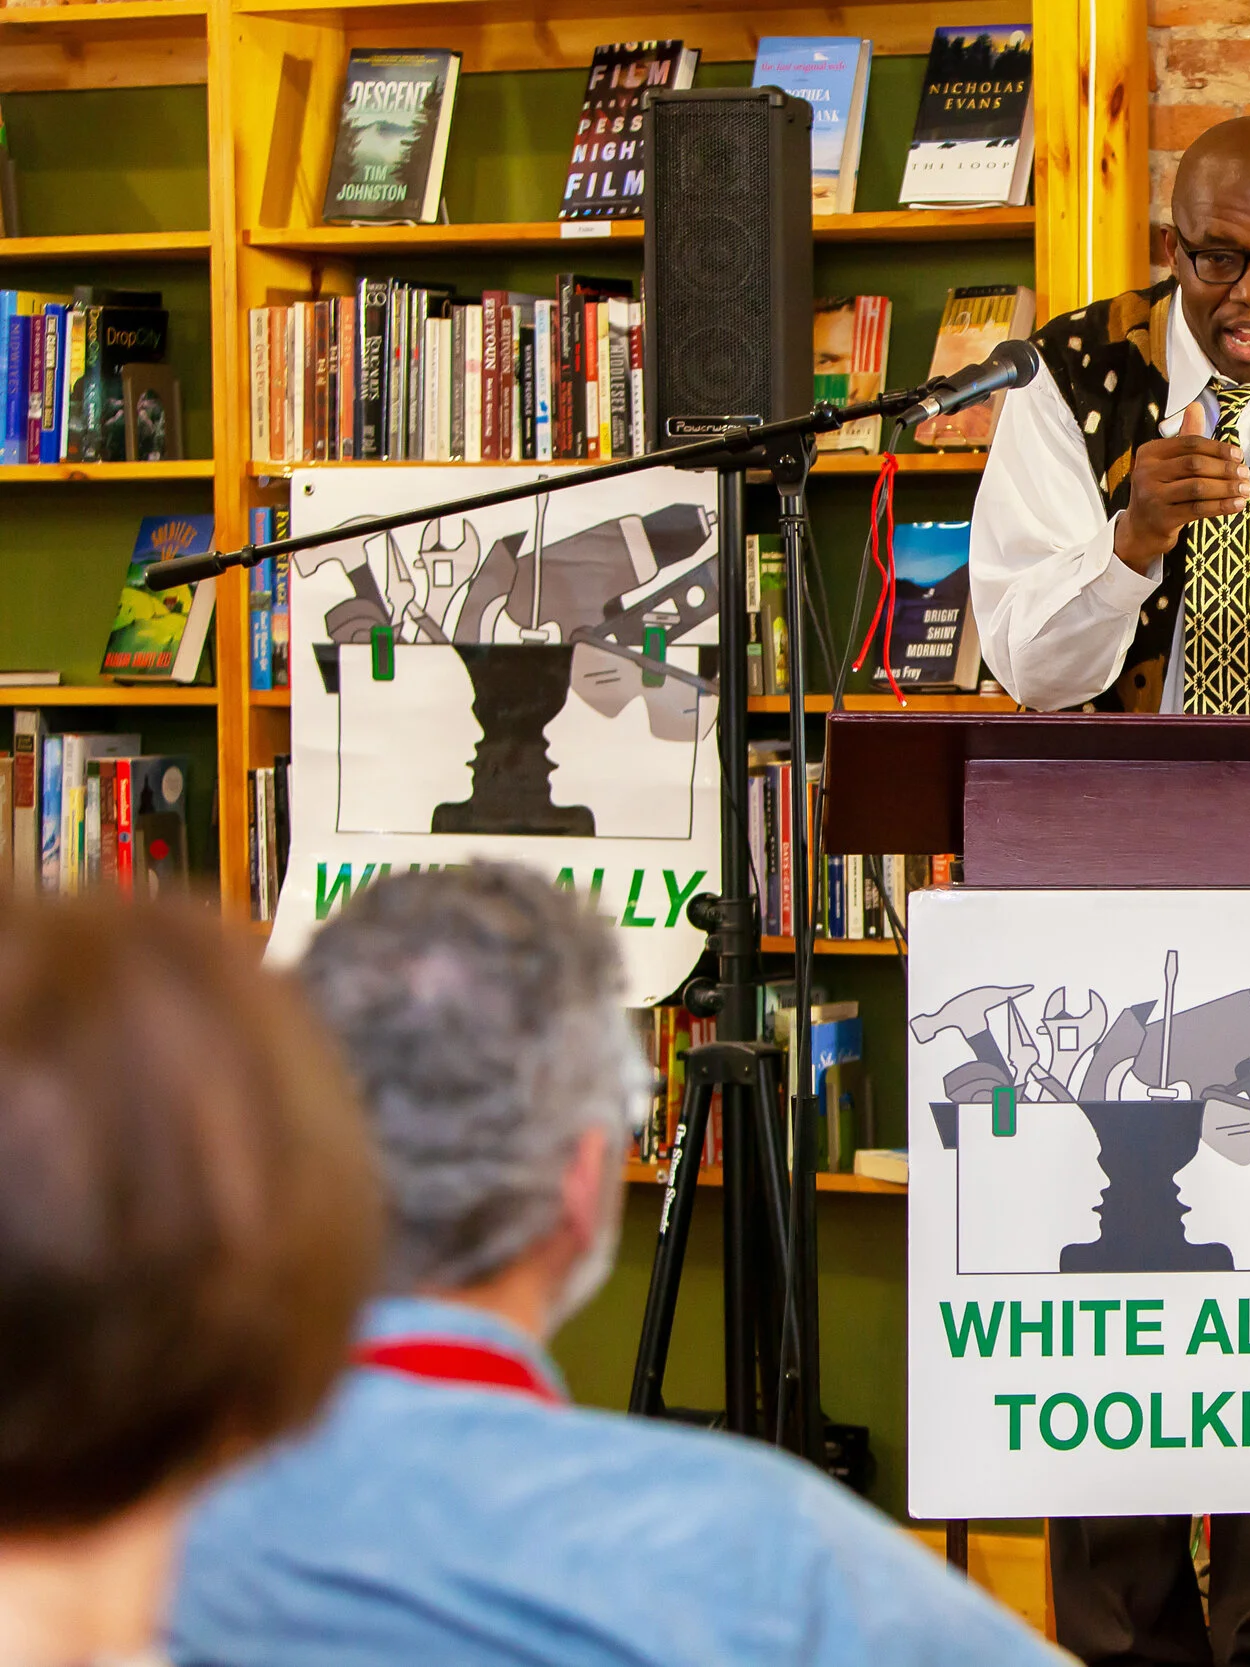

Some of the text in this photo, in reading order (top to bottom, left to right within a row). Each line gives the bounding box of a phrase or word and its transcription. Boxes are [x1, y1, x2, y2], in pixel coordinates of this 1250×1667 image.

[588, 59, 672, 91] FILM
[349, 81, 433, 113] DESCENT
[928, 80, 1025, 96] NICHOLAS
[944, 97, 1003, 111] EVANS
[571, 140, 645, 164] NIGH
[363, 164, 388, 182] TIM
[563, 169, 646, 200] FILM
[336, 183, 408, 202] JOHNSTON
[485, 298, 496, 370] ZEITOUN
[502, 318, 511, 374] ZEITOUN
[525, 344, 533, 416] WINTER PEOPLE
[610, 344, 626, 413] MIDDLESEX
[924, 608, 960, 623] BRIGHT
[926, 626, 957, 640] SHINY
[905, 643, 953, 658] MORNING
[902, 666, 922, 680] Frey
[939, 1299, 1165, 1359] WHITE
